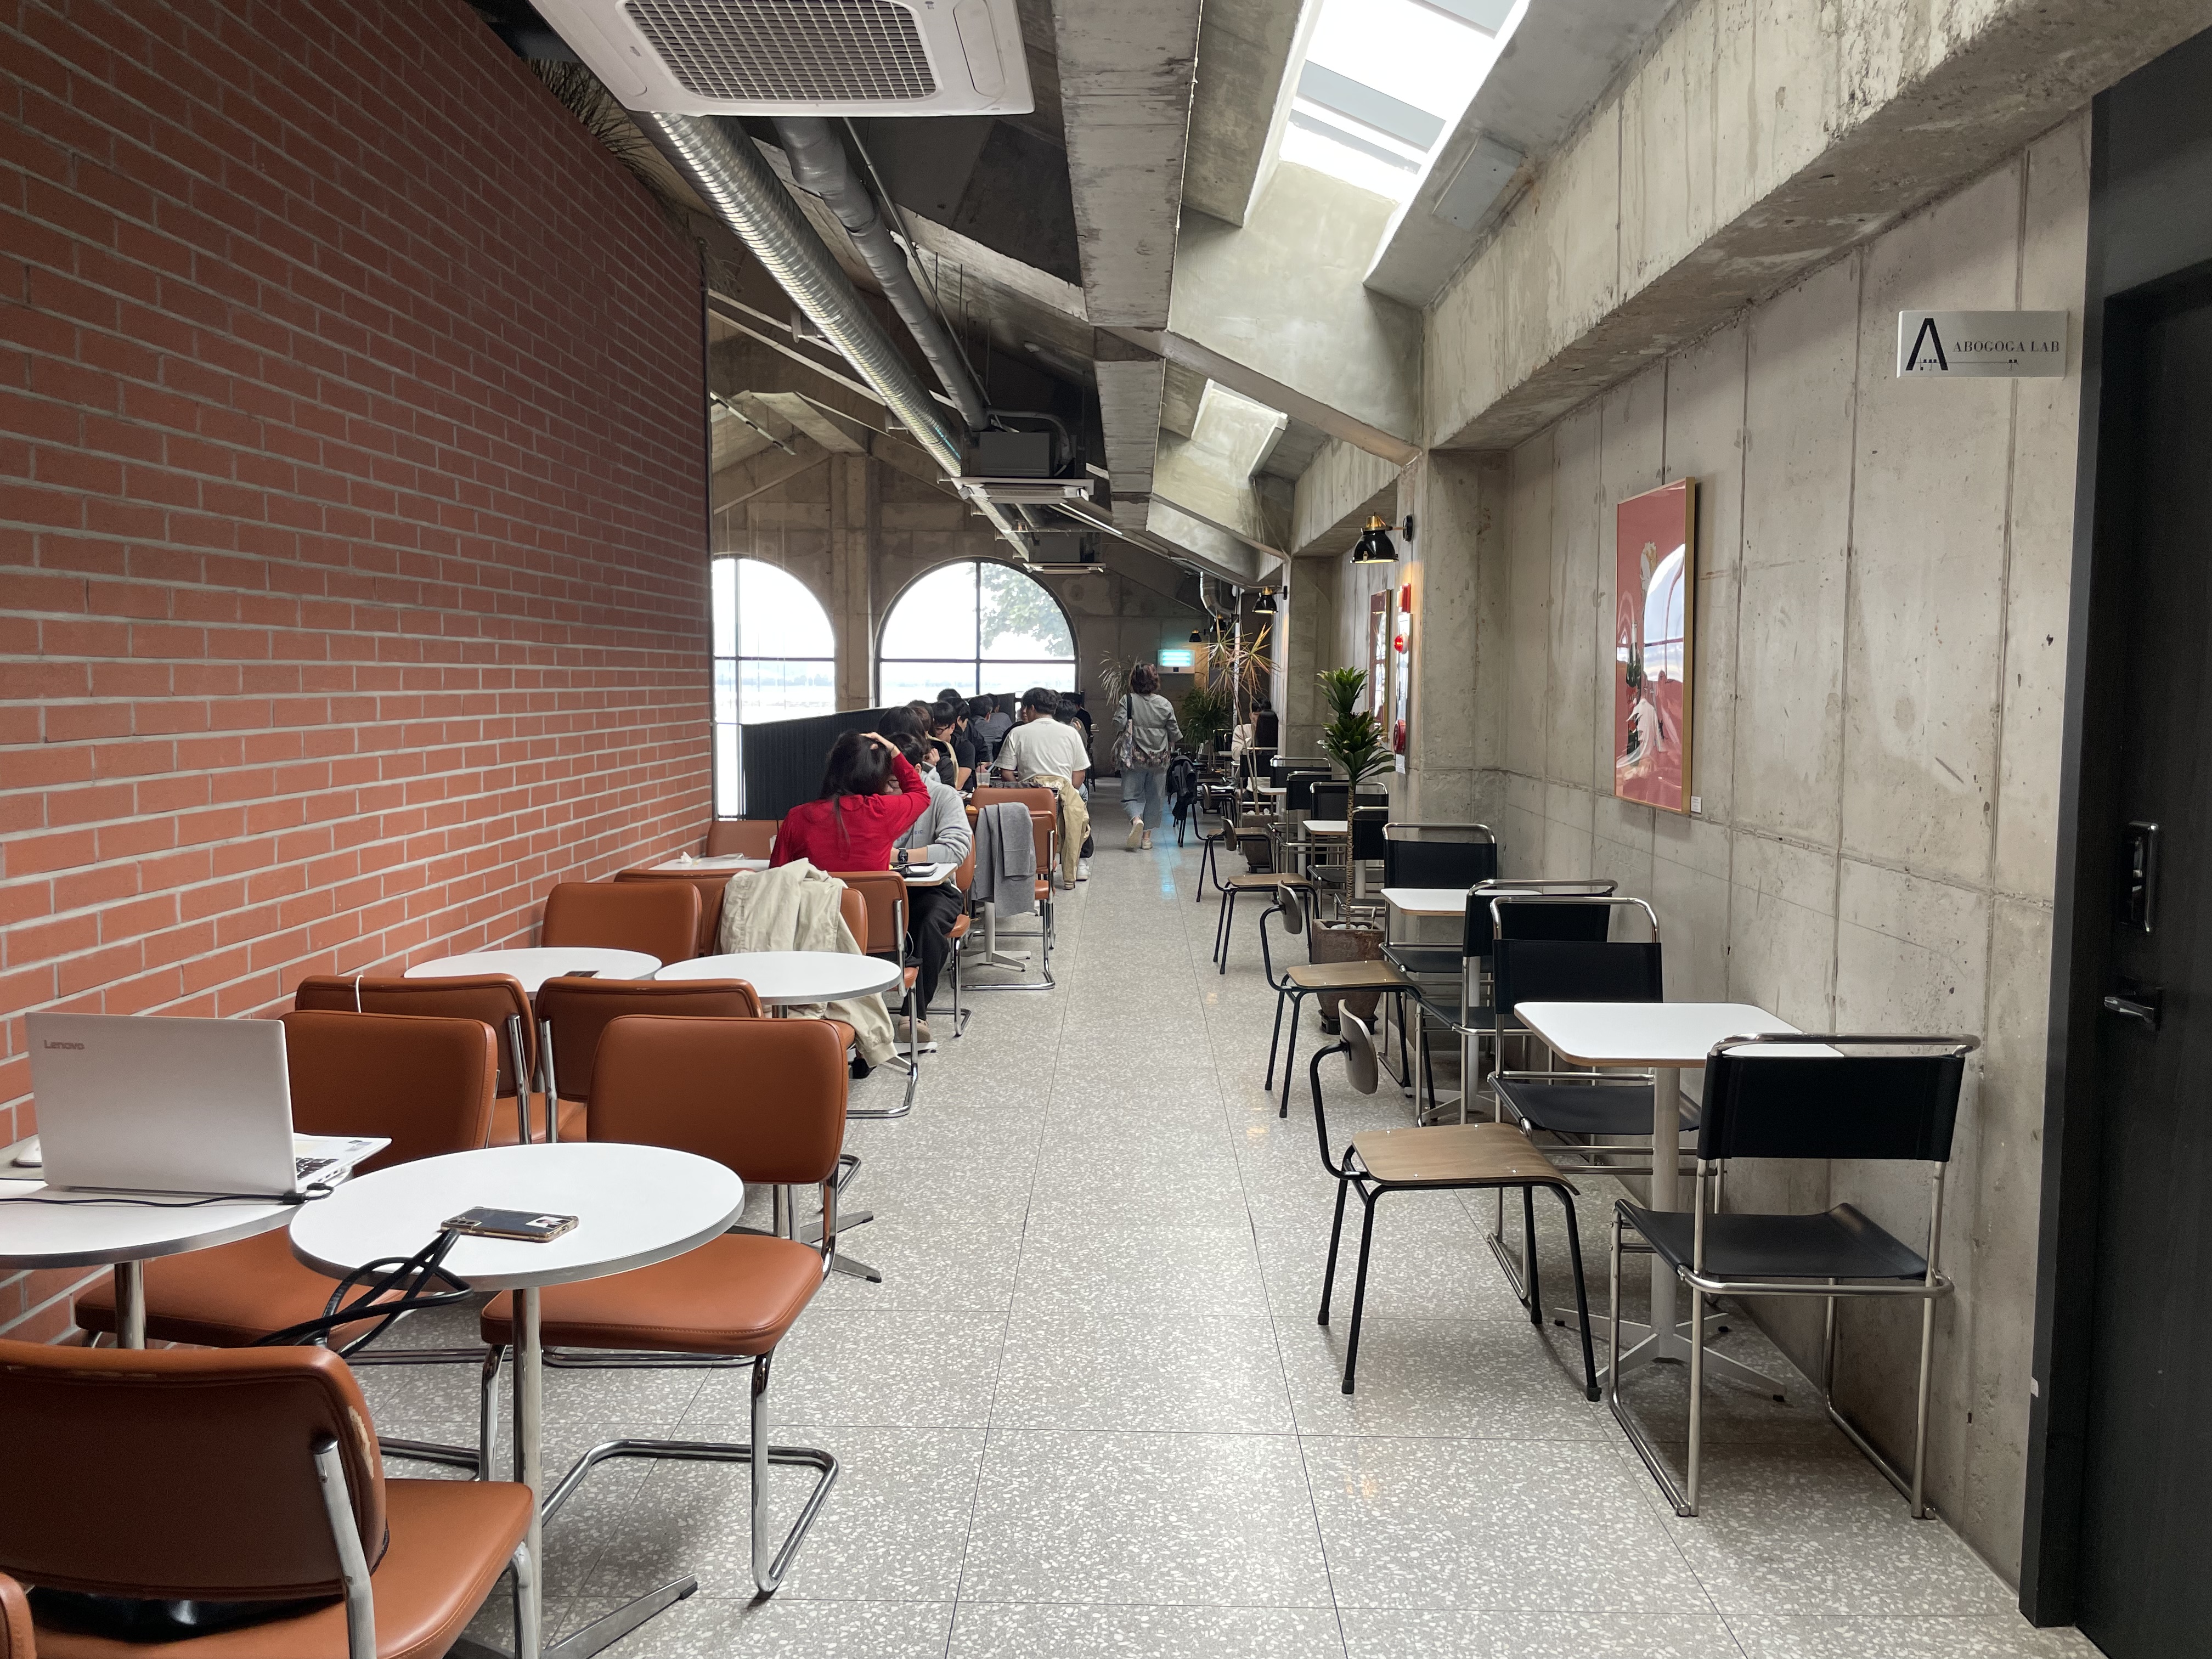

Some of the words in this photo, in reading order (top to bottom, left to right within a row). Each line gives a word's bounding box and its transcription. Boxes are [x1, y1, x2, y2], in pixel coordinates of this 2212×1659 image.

[1953, 340, 2026, 353] ABOGOGA
[2030, 340, 2060, 353] LAB
[44, 1040, 85, 1050] Lenovo
